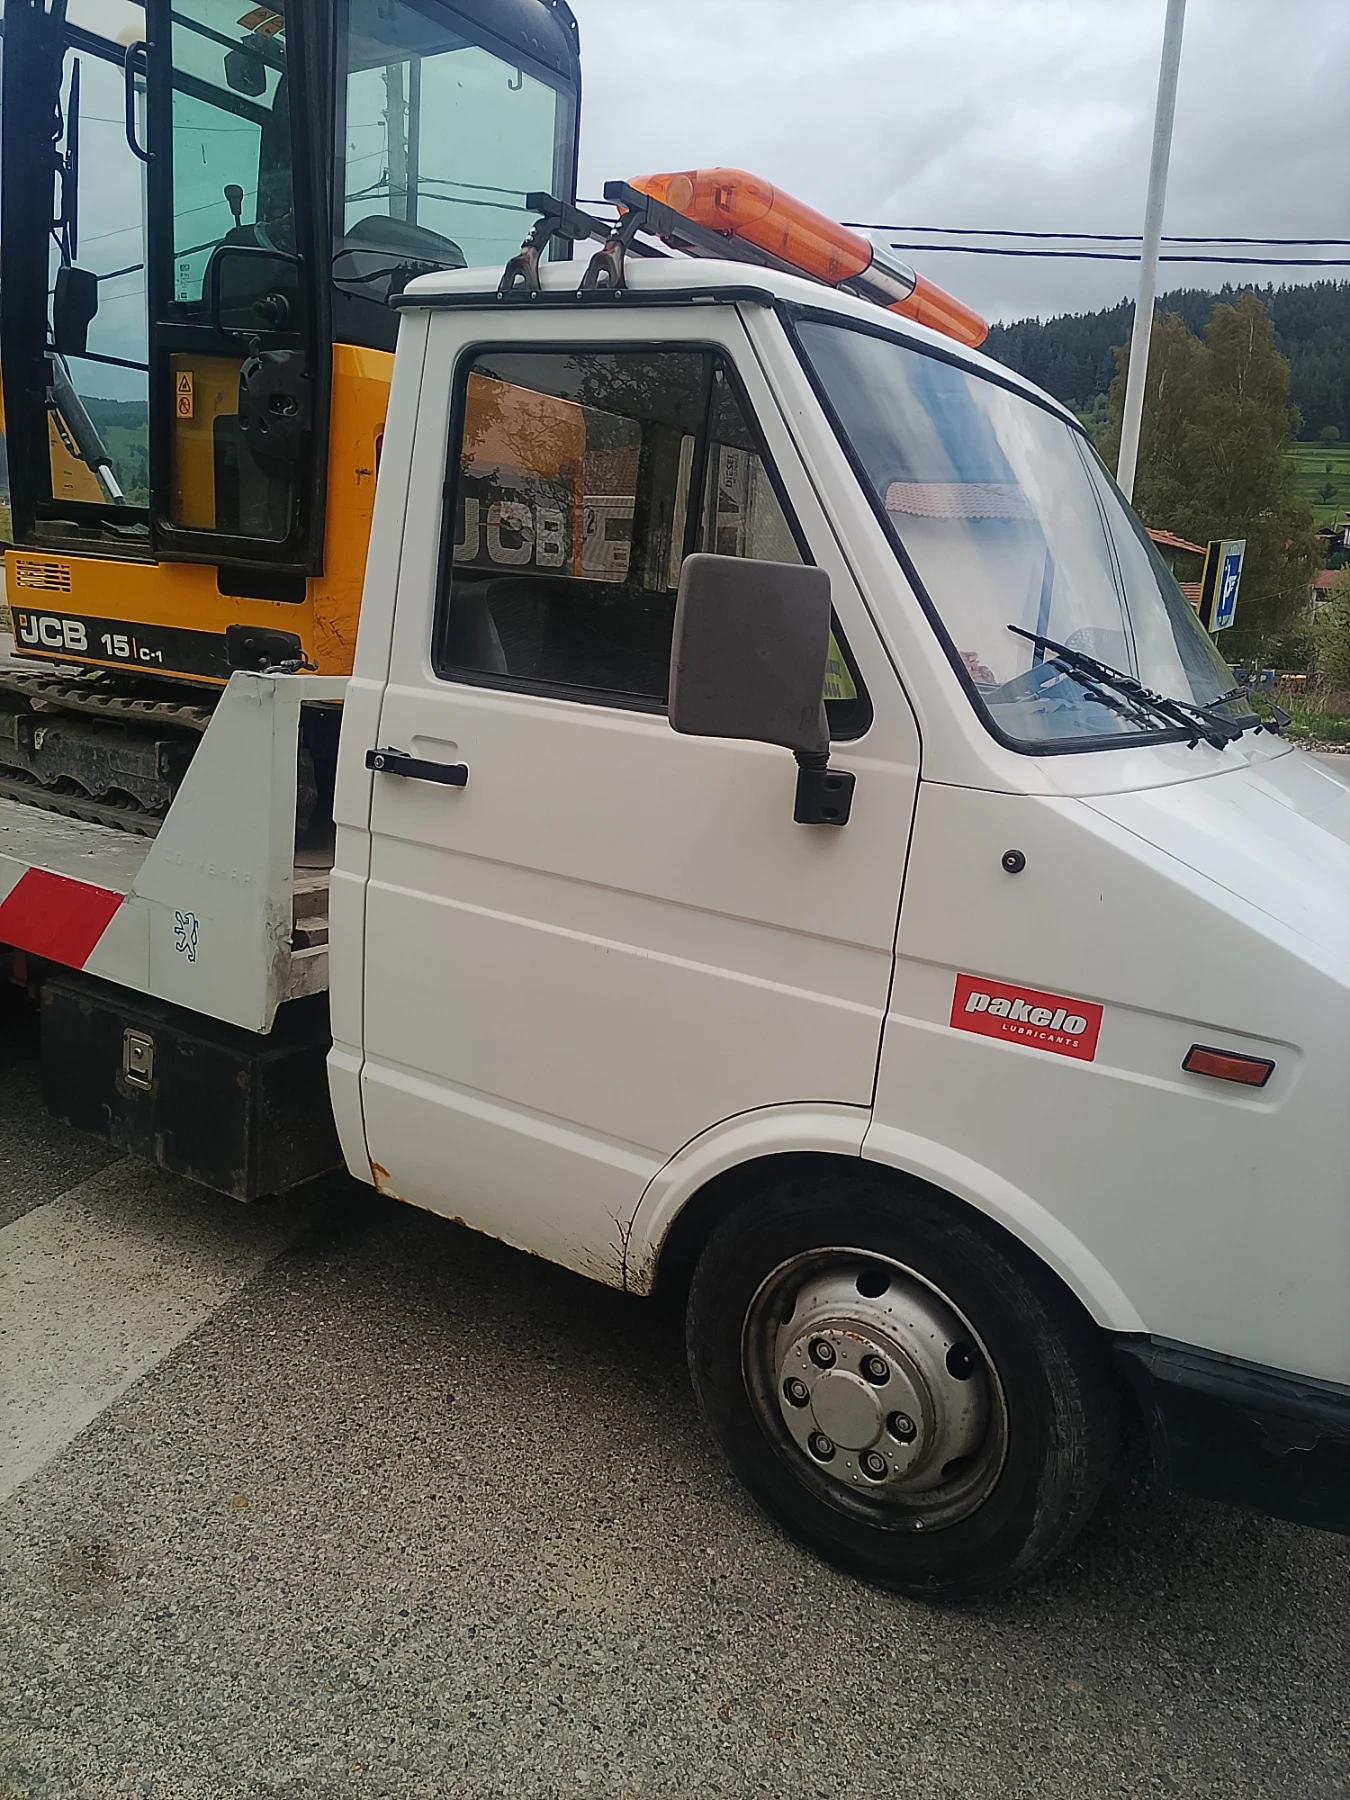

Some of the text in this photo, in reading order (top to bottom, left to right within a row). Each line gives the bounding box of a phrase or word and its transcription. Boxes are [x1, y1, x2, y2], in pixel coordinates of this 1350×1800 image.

[725, 454, 735, 488] DIESEL
[453, 497, 567, 567] JCB
[20, 615, 88, 651] JCB
[101, 633, 130, 657] 15
[964, 991, 1088, 1035] pakelo
[1001, 1023, 1080, 1048] LUBRICANTS
